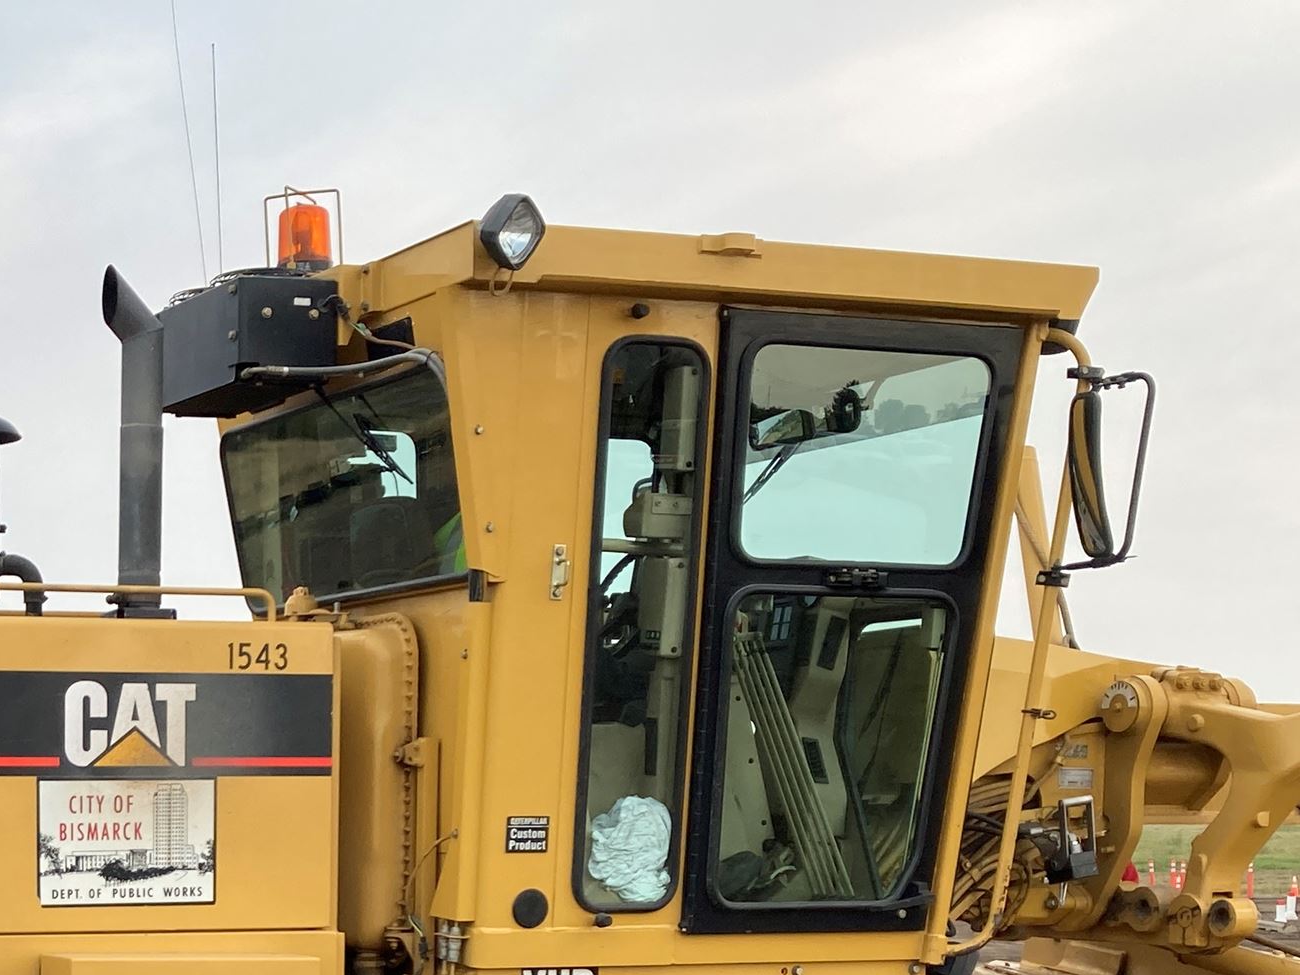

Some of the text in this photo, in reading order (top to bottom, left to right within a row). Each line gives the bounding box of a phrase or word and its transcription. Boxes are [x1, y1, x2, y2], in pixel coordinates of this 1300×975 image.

[227, 642, 288, 670] 1543
[64, 680, 196, 767] CAT
[69, 794, 134, 814] CITY OF
[59, 822, 143, 842] BISMARCK
[510, 828, 546, 839] Custom
[508, 840, 546, 850] Product
[88, 888, 103, 900] OF
[112, 887, 154, 900] PUBLIC
[163, 886, 203, 898] WORKS
